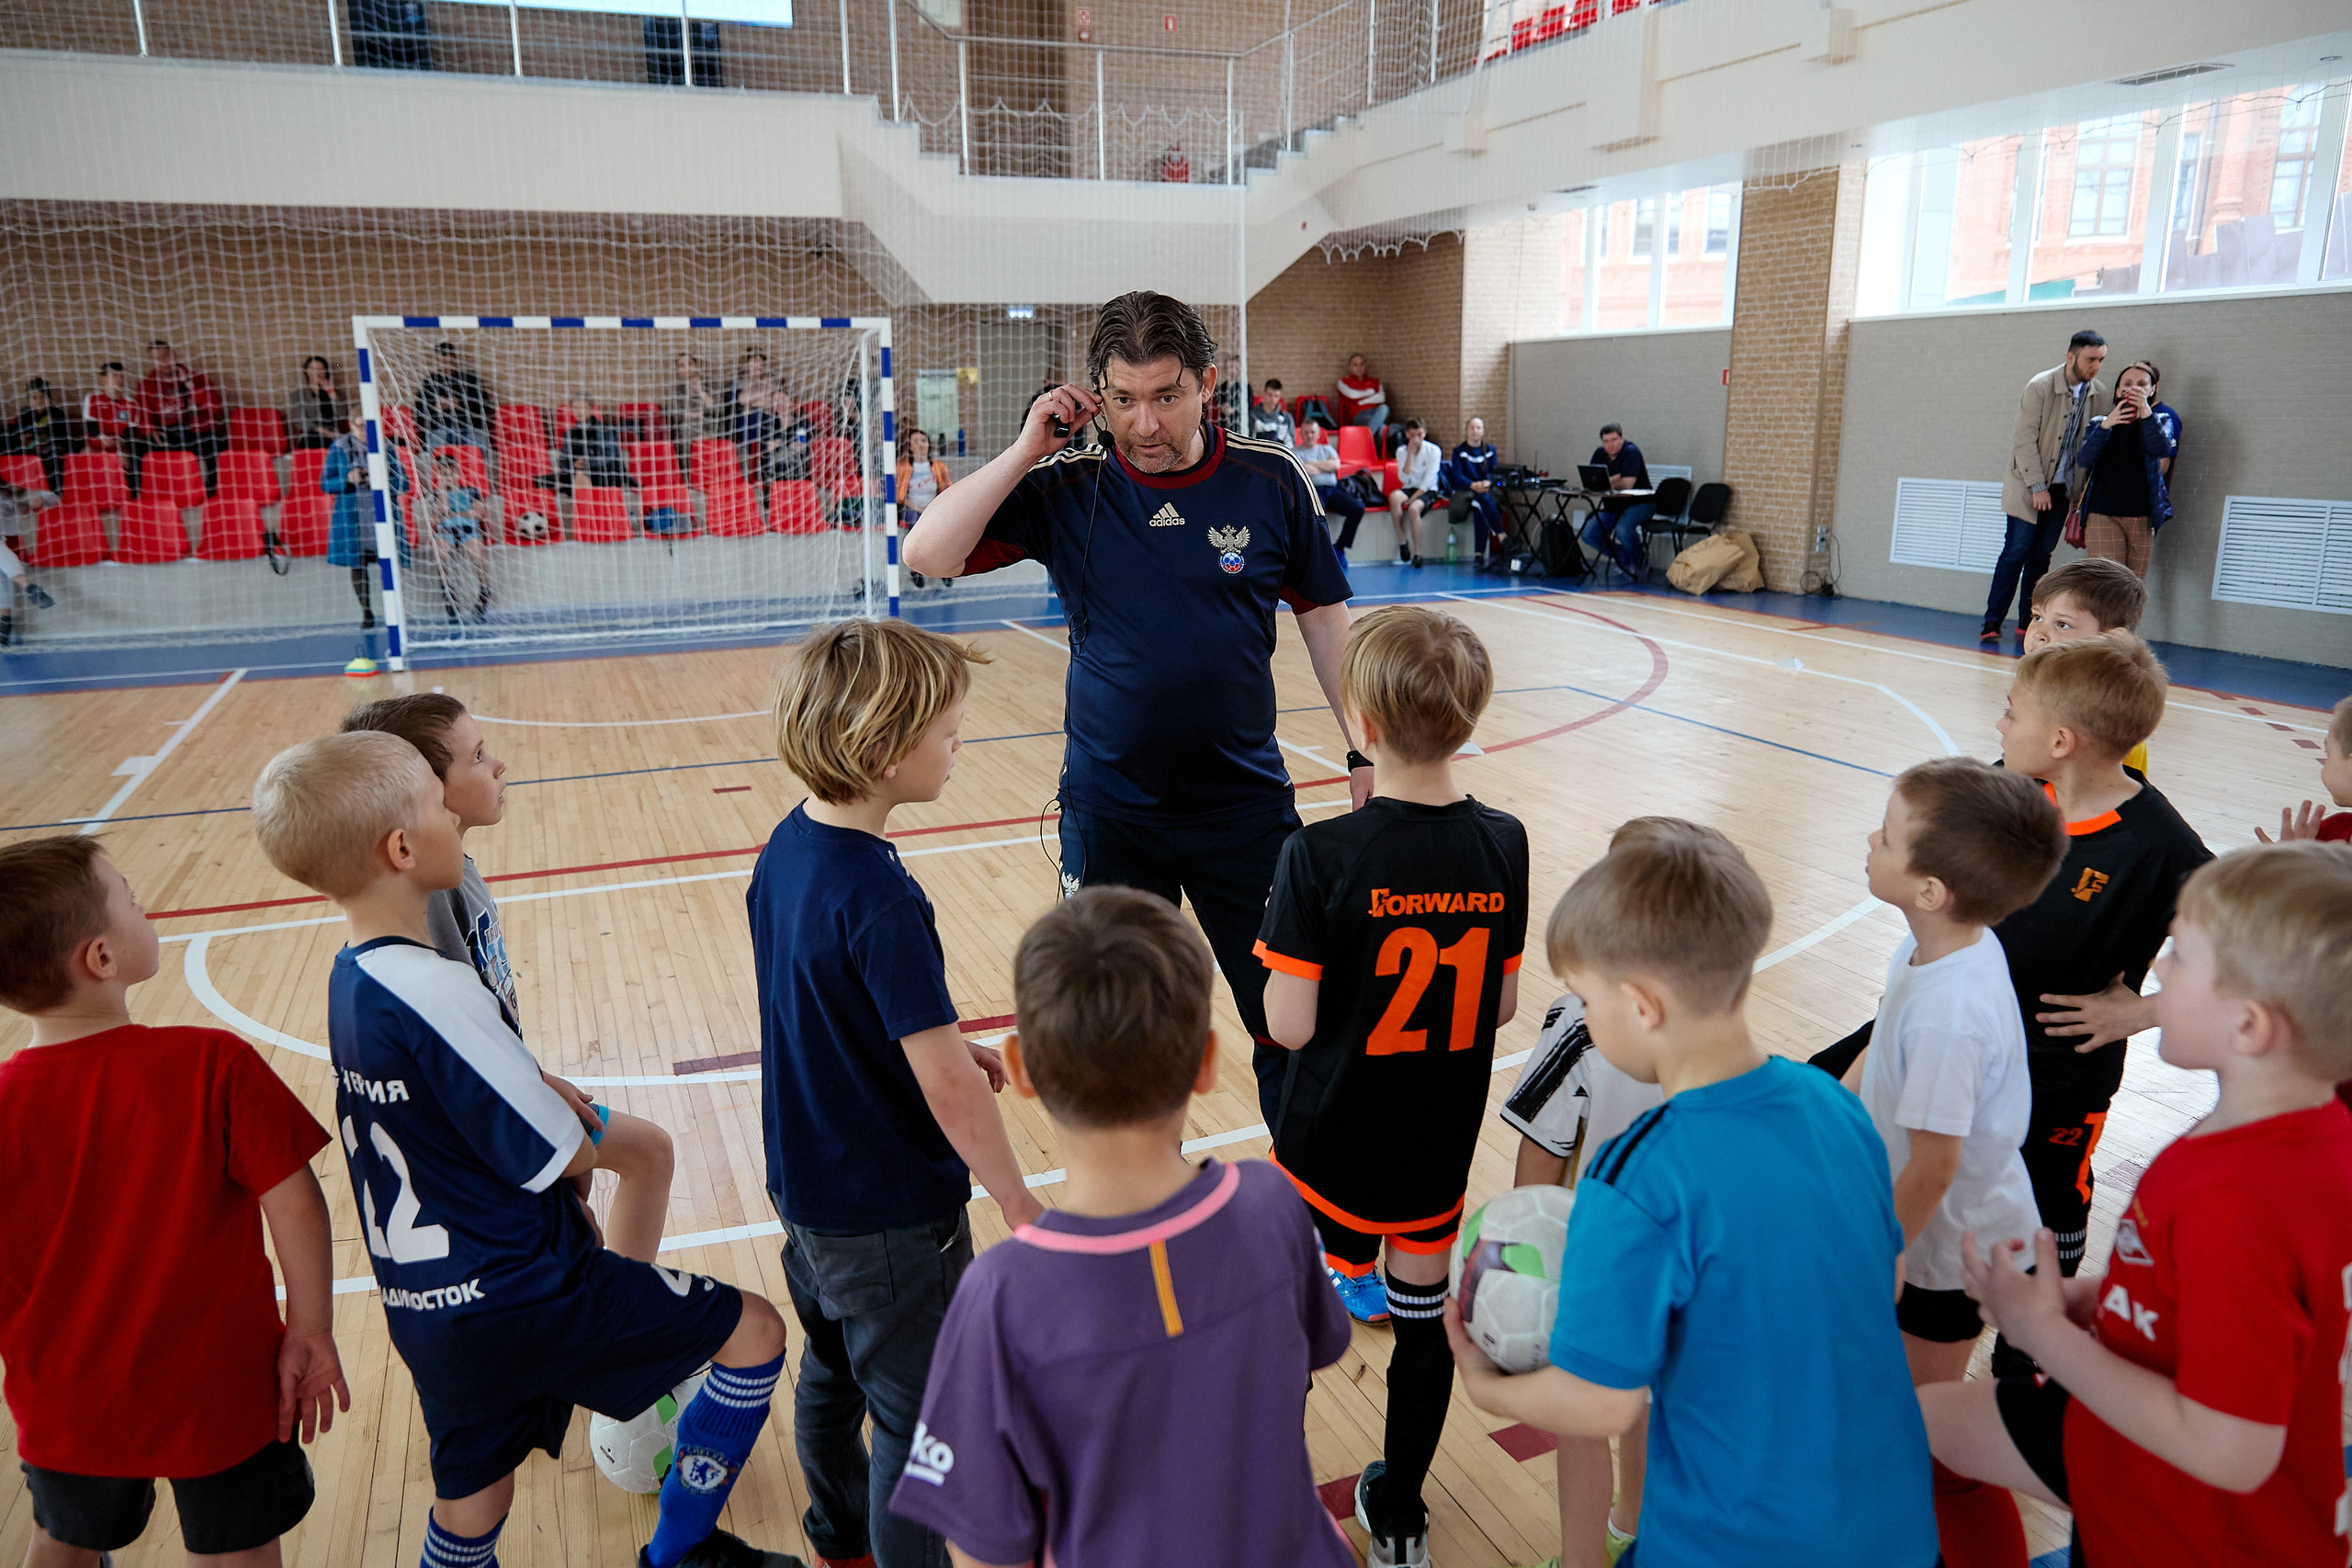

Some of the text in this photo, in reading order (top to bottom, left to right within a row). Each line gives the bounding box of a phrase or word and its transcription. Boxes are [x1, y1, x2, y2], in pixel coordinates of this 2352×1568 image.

[1149, 517, 1186, 527] adidas
[1369, 888, 1506, 918] FORWARD
[1365, 927, 1491, 1055] 21
[2048, 1127, 2084, 1146] 22
[2103, 1284, 2160, 1342] АК
[910, 1420, 955, 1474] ko
